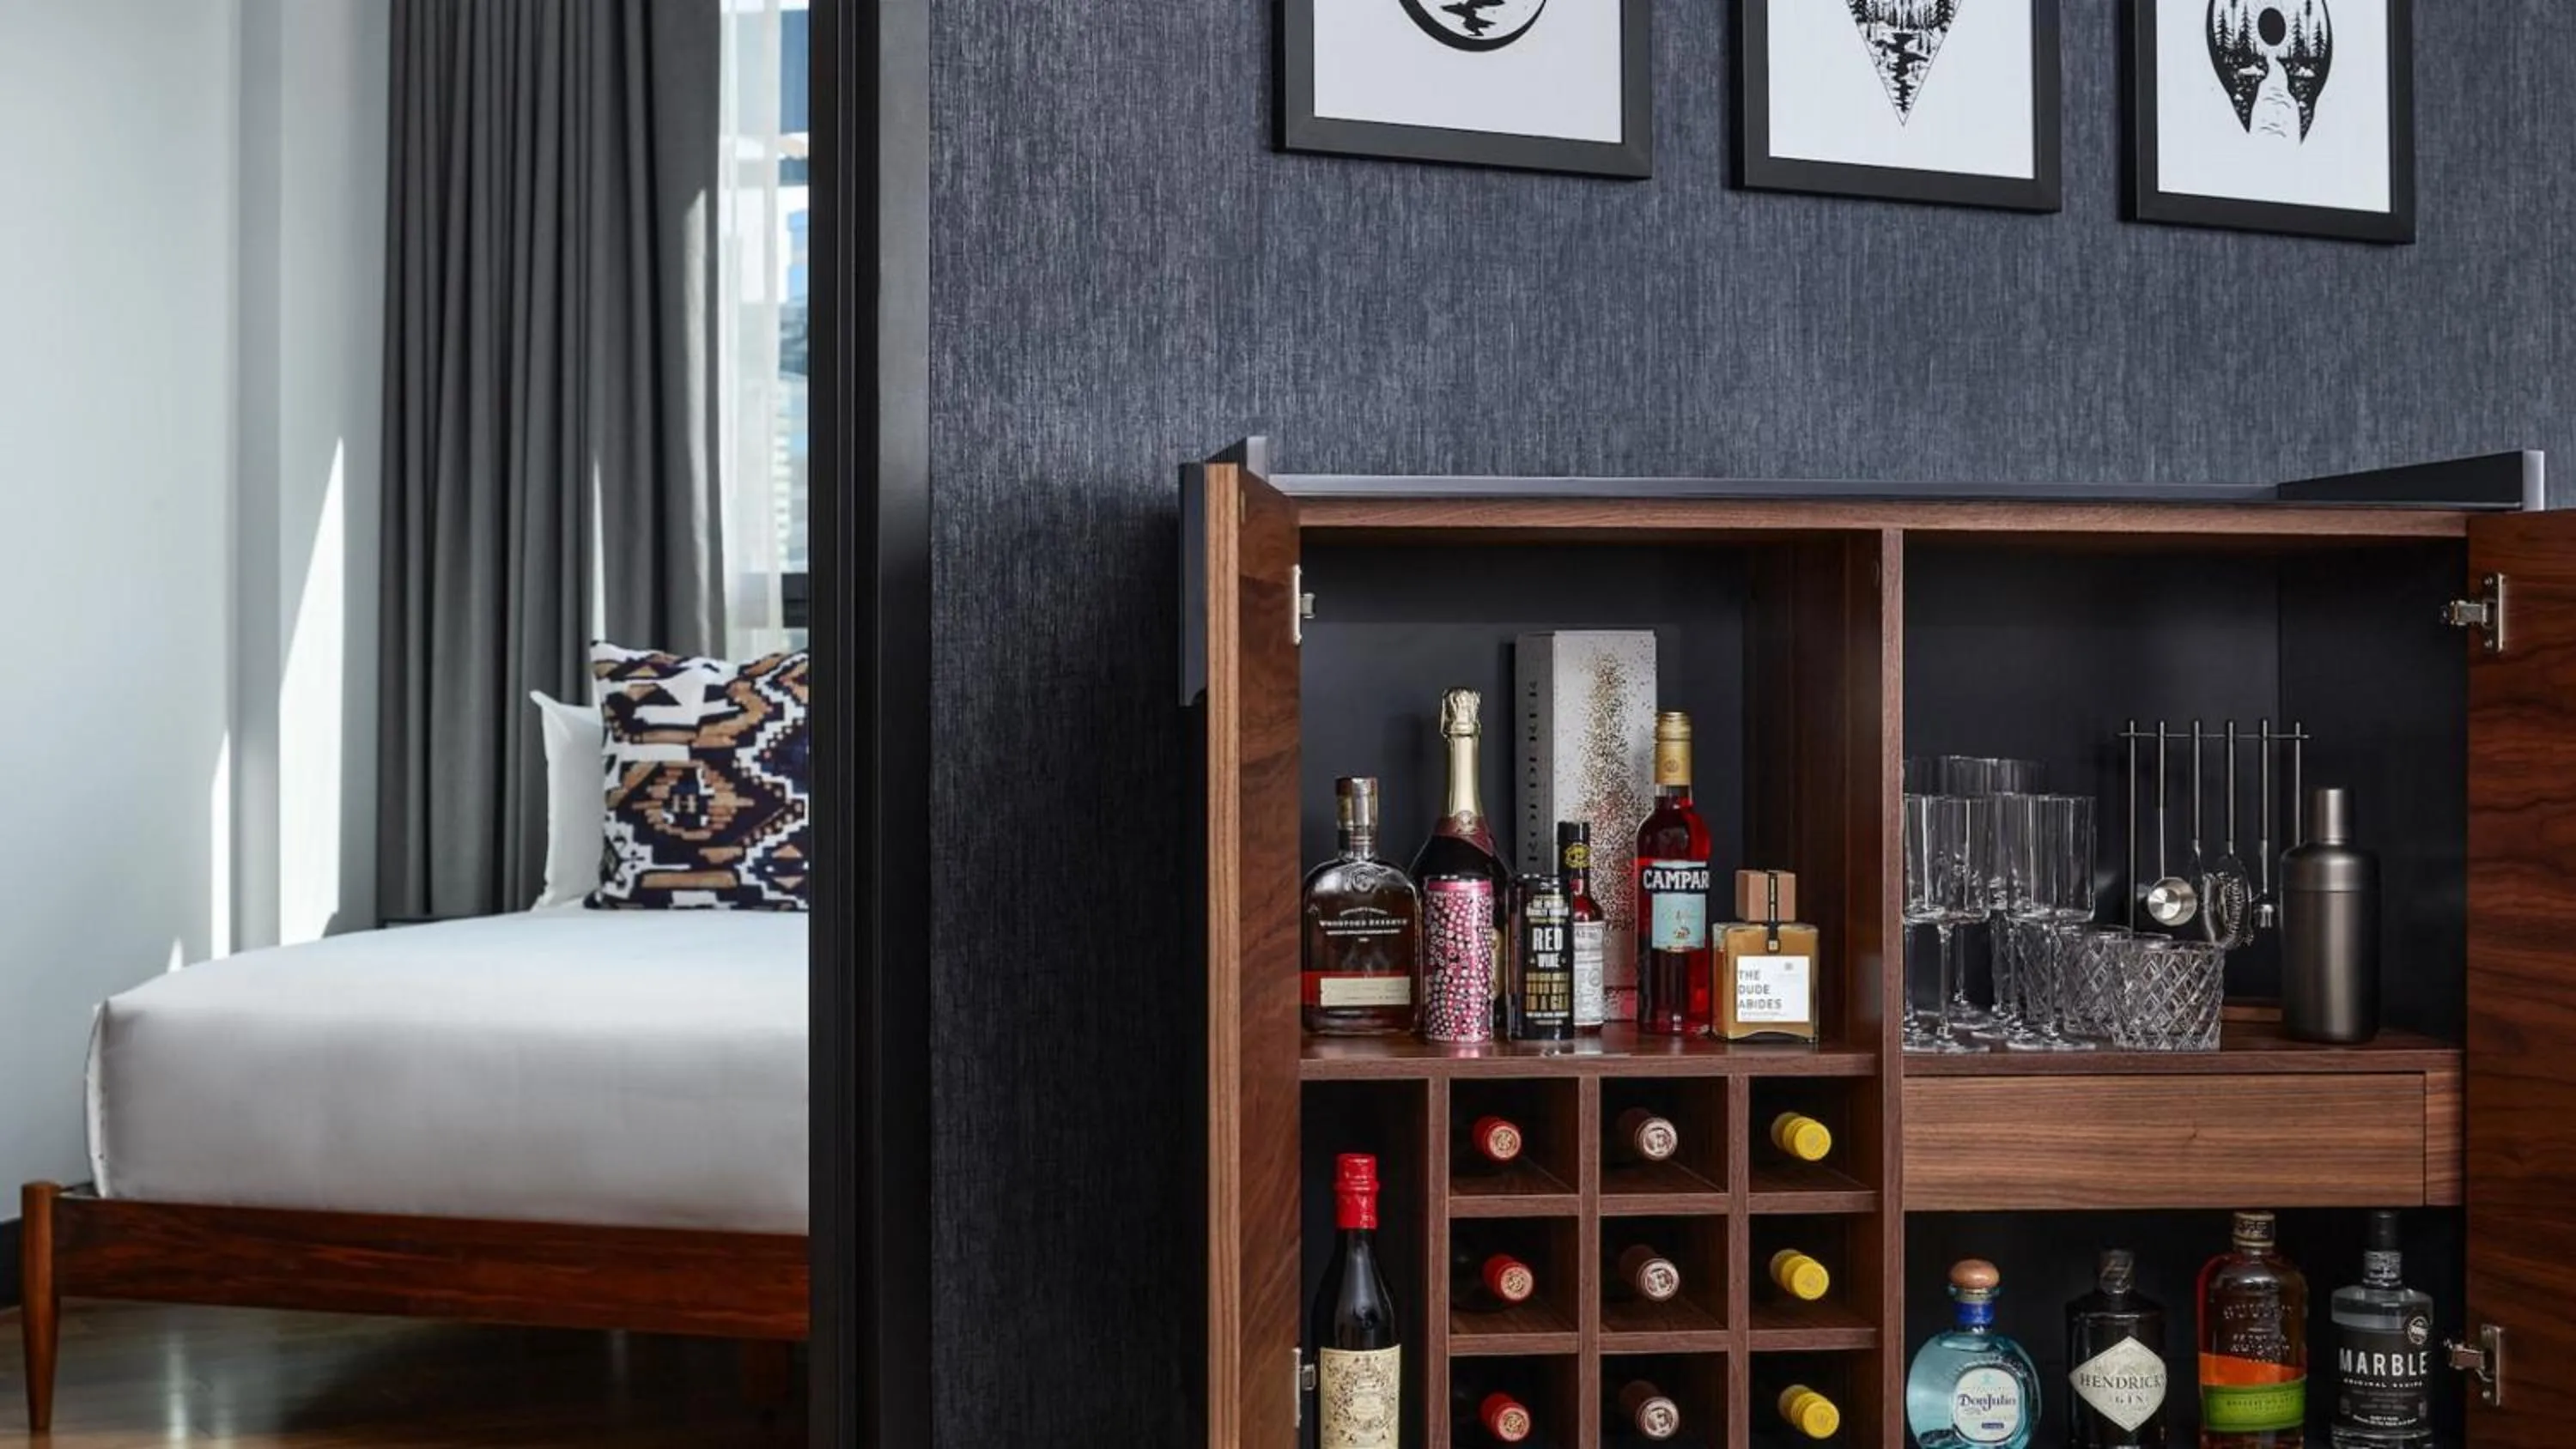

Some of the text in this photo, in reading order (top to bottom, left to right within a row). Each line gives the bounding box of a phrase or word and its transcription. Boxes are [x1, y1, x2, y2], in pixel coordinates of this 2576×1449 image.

[1643, 870, 1710, 889] CAMPAR
[1533, 927, 1564, 951] RED
[1537, 953, 1560, 968] WINE
[1739, 970, 1760, 980] THE
[1738, 984, 1771, 995] DUDE
[1739, 998, 1783, 1009] ABIDES
[2338, 1348, 2429, 1376] MARBLE
[2079, 1373, 2166, 1390] HENDRICK
[2115, 1395, 2146, 1405] GIN
